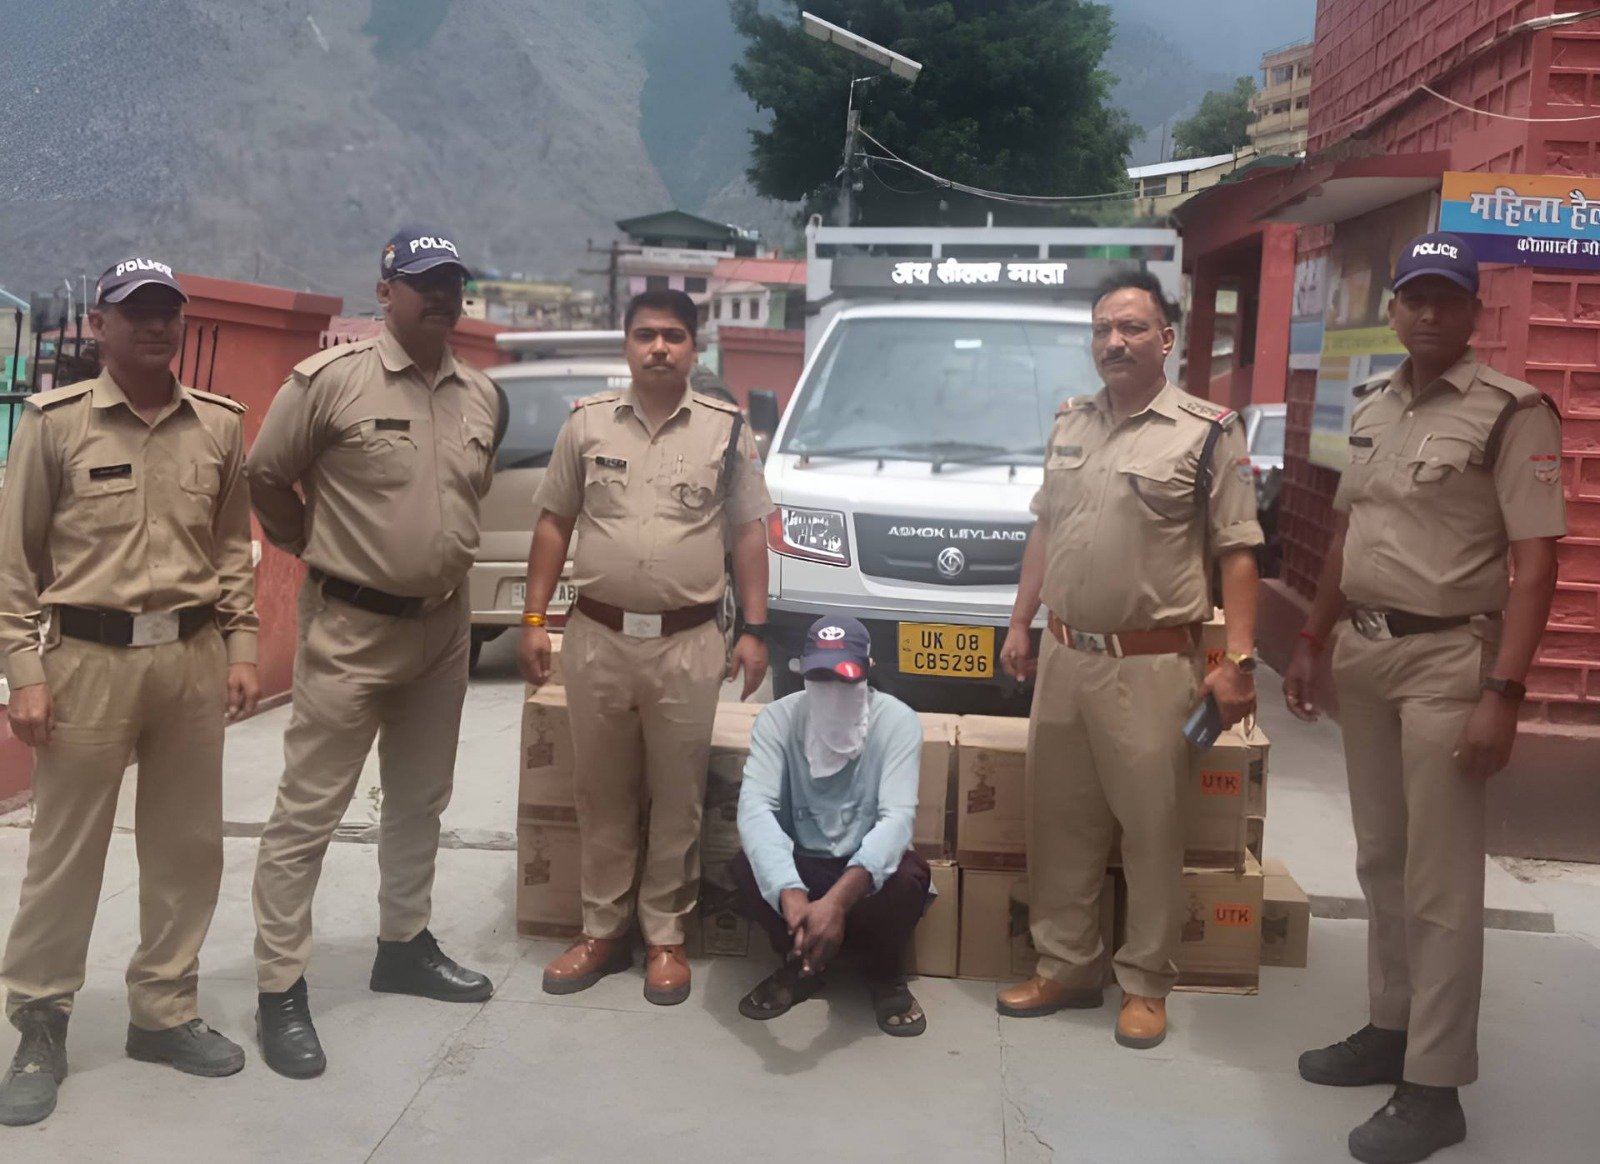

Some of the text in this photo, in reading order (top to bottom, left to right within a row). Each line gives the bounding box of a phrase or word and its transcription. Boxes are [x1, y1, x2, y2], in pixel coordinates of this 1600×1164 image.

[1470, 186, 1564, 227] महिला
[1412, 242, 1458, 259] POLICE
[888, 526, 1026, 541] ASHOK LEYLAND
[921, 631, 943, 649] UK
[956, 633, 979, 651] 08
[914, 652, 987, 672] CB5296
[1202, 774, 1237, 790] UTK
[1216, 908, 1249, 923] UTK
